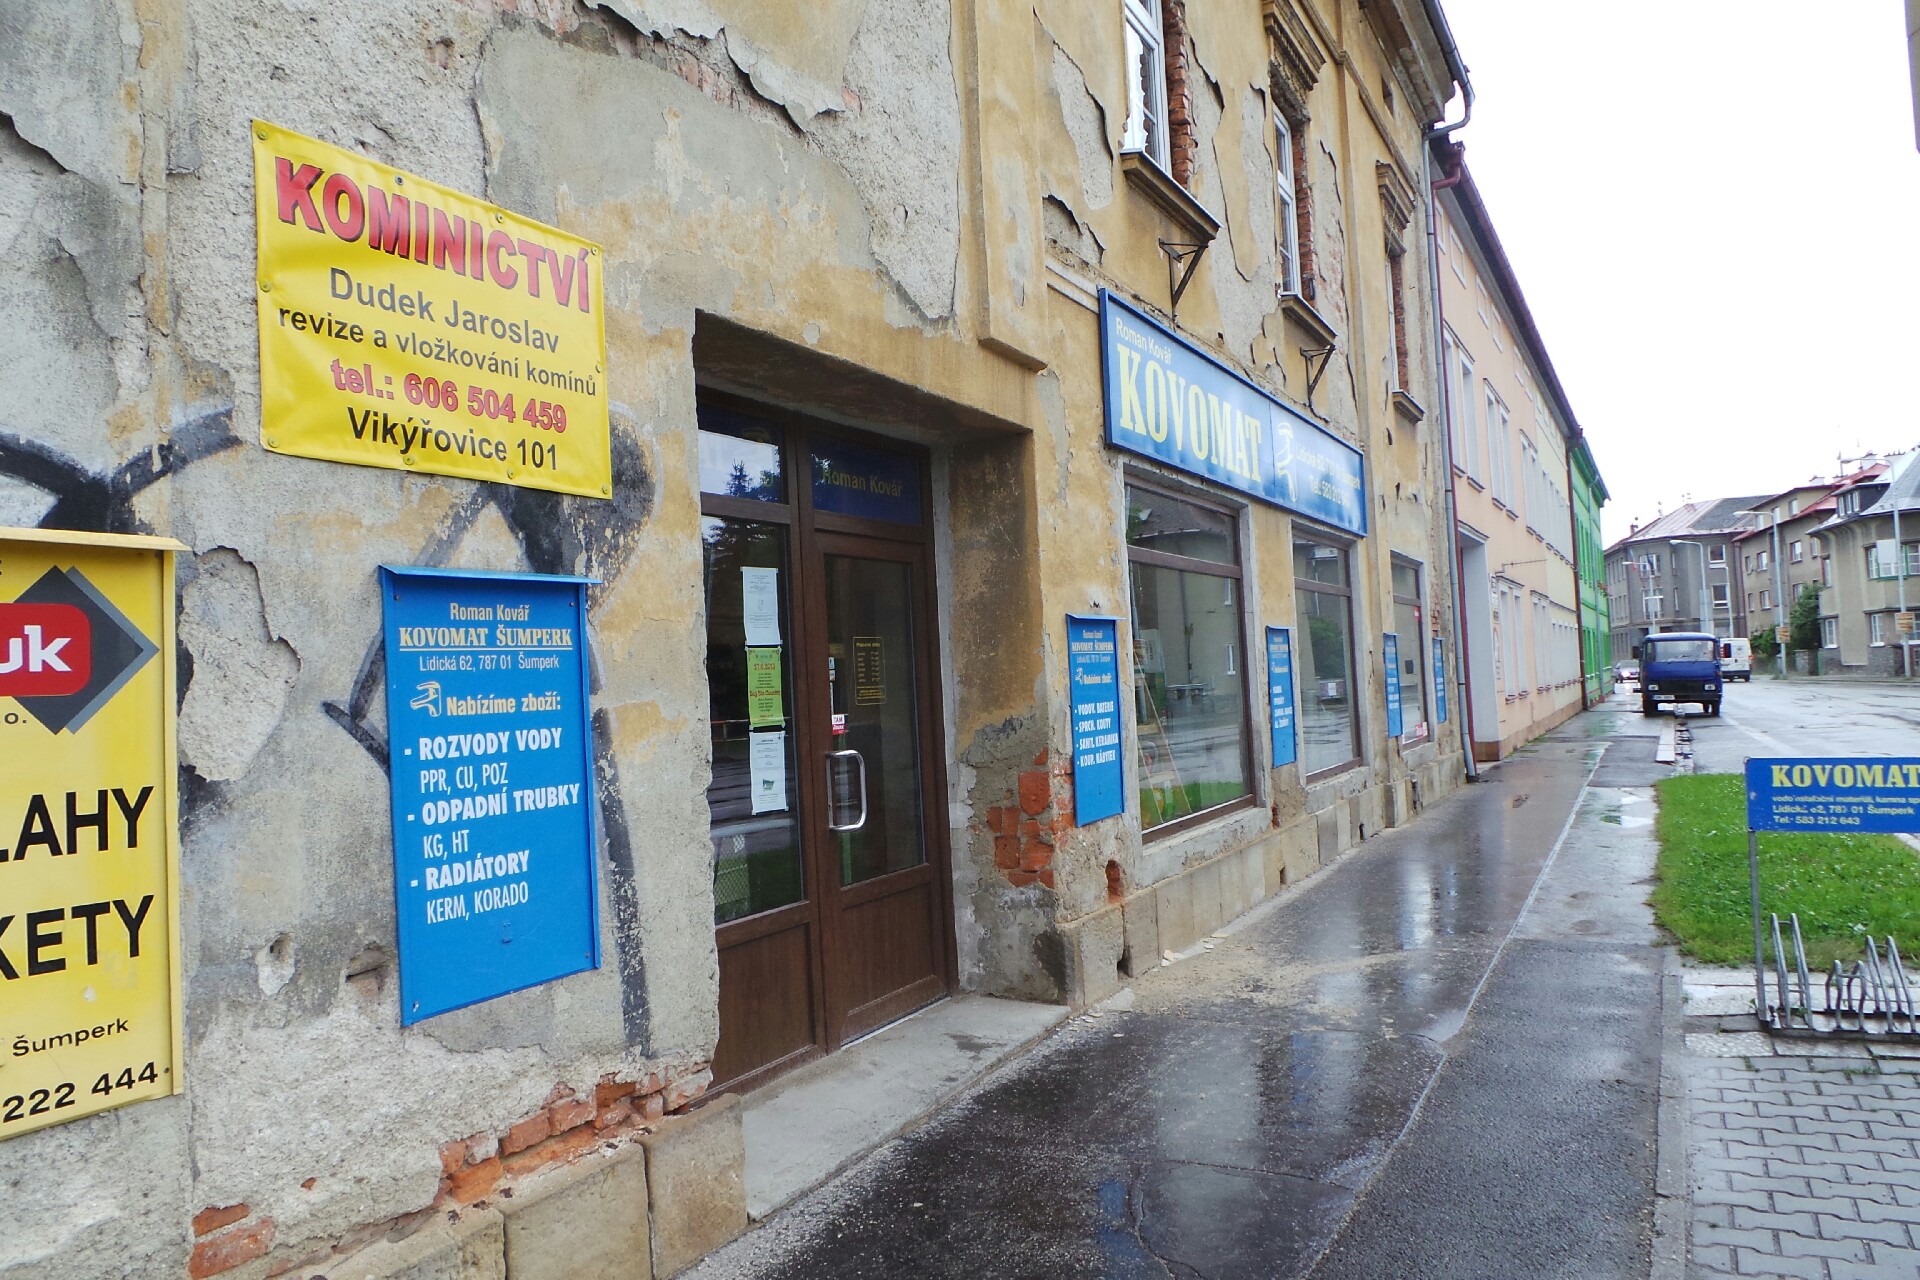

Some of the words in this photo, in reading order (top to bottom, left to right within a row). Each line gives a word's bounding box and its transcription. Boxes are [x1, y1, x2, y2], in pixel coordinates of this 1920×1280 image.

[275, 156, 590, 313] KOMINICTVÍ
[330, 267, 435, 322] Dudek
[444, 300, 559, 353] Jaroslav
[279, 307, 364, 343] revize
[373, 329, 387, 348] a
[396, 332, 519, 379] vložkování
[526, 360, 596, 396] komínů
[1115, 317, 1147, 351] Roman
[1148, 336, 1171, 365] Kovář
[330, 359, 394, 400] tel.:
[404, 373, 458, 412] 606
[467, 386, 516, 423] 504
[523, 398, 566, 433] 459
[1117, 343, 1262, 482] KOVOMAT
[347, 407, 507, 462] Vikýřovice
[517, 438, 557, 470] 101
[450, 603, 493, 621] Roman
[496, 604, 530, 621] Kovář
[399, 627, 488, 646] KOVOMAT
[496, 624, 572, 646] ŠUMPERK
[419, 656, 456, 671] Lidická
[459, 657, 475, 672] 62,
[478, 656, 496, 670] 787
[500, 656, 511, 669] 01
[518, 652, 559, 671] Šumperk
[446, 695, 516, 716] Nabízíme
[521, 691, 561, 712] zboží:
[1096, 701, 1114, 713] BATERIE
[1096, 733, 1119, 747] KERAMIKA
[1097, 718, 1111, 730] KOUTY
[419, 731, 510, 760] ROZVODY
[515, 728, 562, 751] VODY
[420, 768, 451, 795] PPR,
[455, 766, 478, 792] CU,
[482, 762, 508, 786] POZ
[1771, 764, 1920, 787] KOVOMAT
[422, 787, 507, 825] ODPADNÍ
[513, 783, 580, 812] TRUBKY
[1795, 816, 1815, 824] 583
[1817, 816, 1838, 825] 212
[1867, 804, 1915, 815] Šumperk
[0, 785, 154, 862] AHY
[423, 834, 447, 860] KG,
[452, 830, 469, 854] HT
[425, 850, 529, 890] RADIÁTORY
[426, 895, 470, 924] KERM,
[474, 881, 528, 913] KORADO
[12, 1018, 129, 1057] Šumperk
[3, 1082, 76, 1123] 222
[91, 1061, 158, 1096] 444
